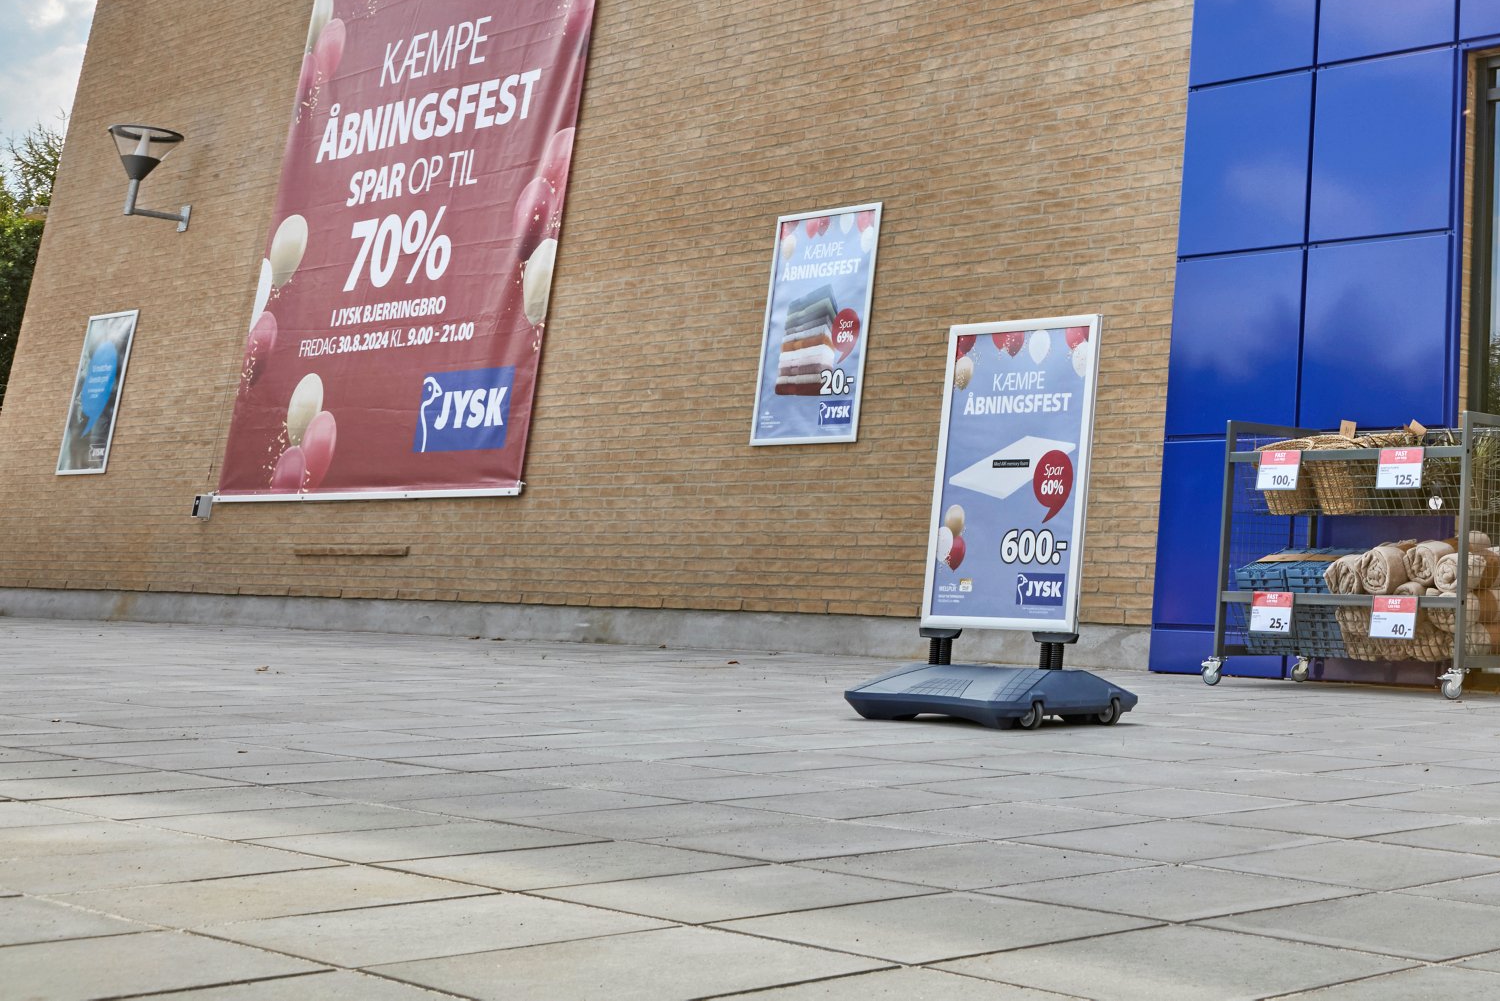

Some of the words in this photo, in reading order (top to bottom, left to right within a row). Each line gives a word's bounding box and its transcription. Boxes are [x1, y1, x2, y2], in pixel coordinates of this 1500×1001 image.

[379, 15, 492, 87] KÆMPE
[315, 68, 542, 164] ÅBNINGSFEST
[346, 162, 406, 207] SPAR
[408, 155, 443, 195] OP
[449, 149, 478, 188] TIL
[342, 205, 452, 293] 70%
[803, 241, 844, 260] KÆMPE
[782, 258, 862, 282] ÅBNINGSFEST
[336, 306, 363, 326] JYSK
[363, 295, 447, 322] BJERRINGBRO
[839, 319, 854, 331] Spar
[298, 336, 337, 358] FREDAG
[337, 330, 390, 354] 30.8.2024
[390, 329, 405, 348] KL.
[407, 326, 433, 347] 9.00
[440, 321, 475, 343] 21.00
[836, 330, 854, 343] 69%
[820, 368, 854, 395] 20.-
[992, 370, 1046, 391] KÆMPE
[433, 386, 508, 431] JYSK
[824, 405, 850, 419] JYSK
[963, 391, 1073, 415] ÅBNINGSFEST
[1043, 463, 1065, 479] Spar
[1272, 475, 1295, 486] 100,-
[1394, 474, 1419, 486] 125,-
[1040, 479, 1064, 495] 60%
[1000, 528, 1068, 565] 600.-
[1025, 580, 1063, 598] JYSK
[1269, 617, 1288, 630] 25,-
[1391, 623, 1411, 636] 40,-
